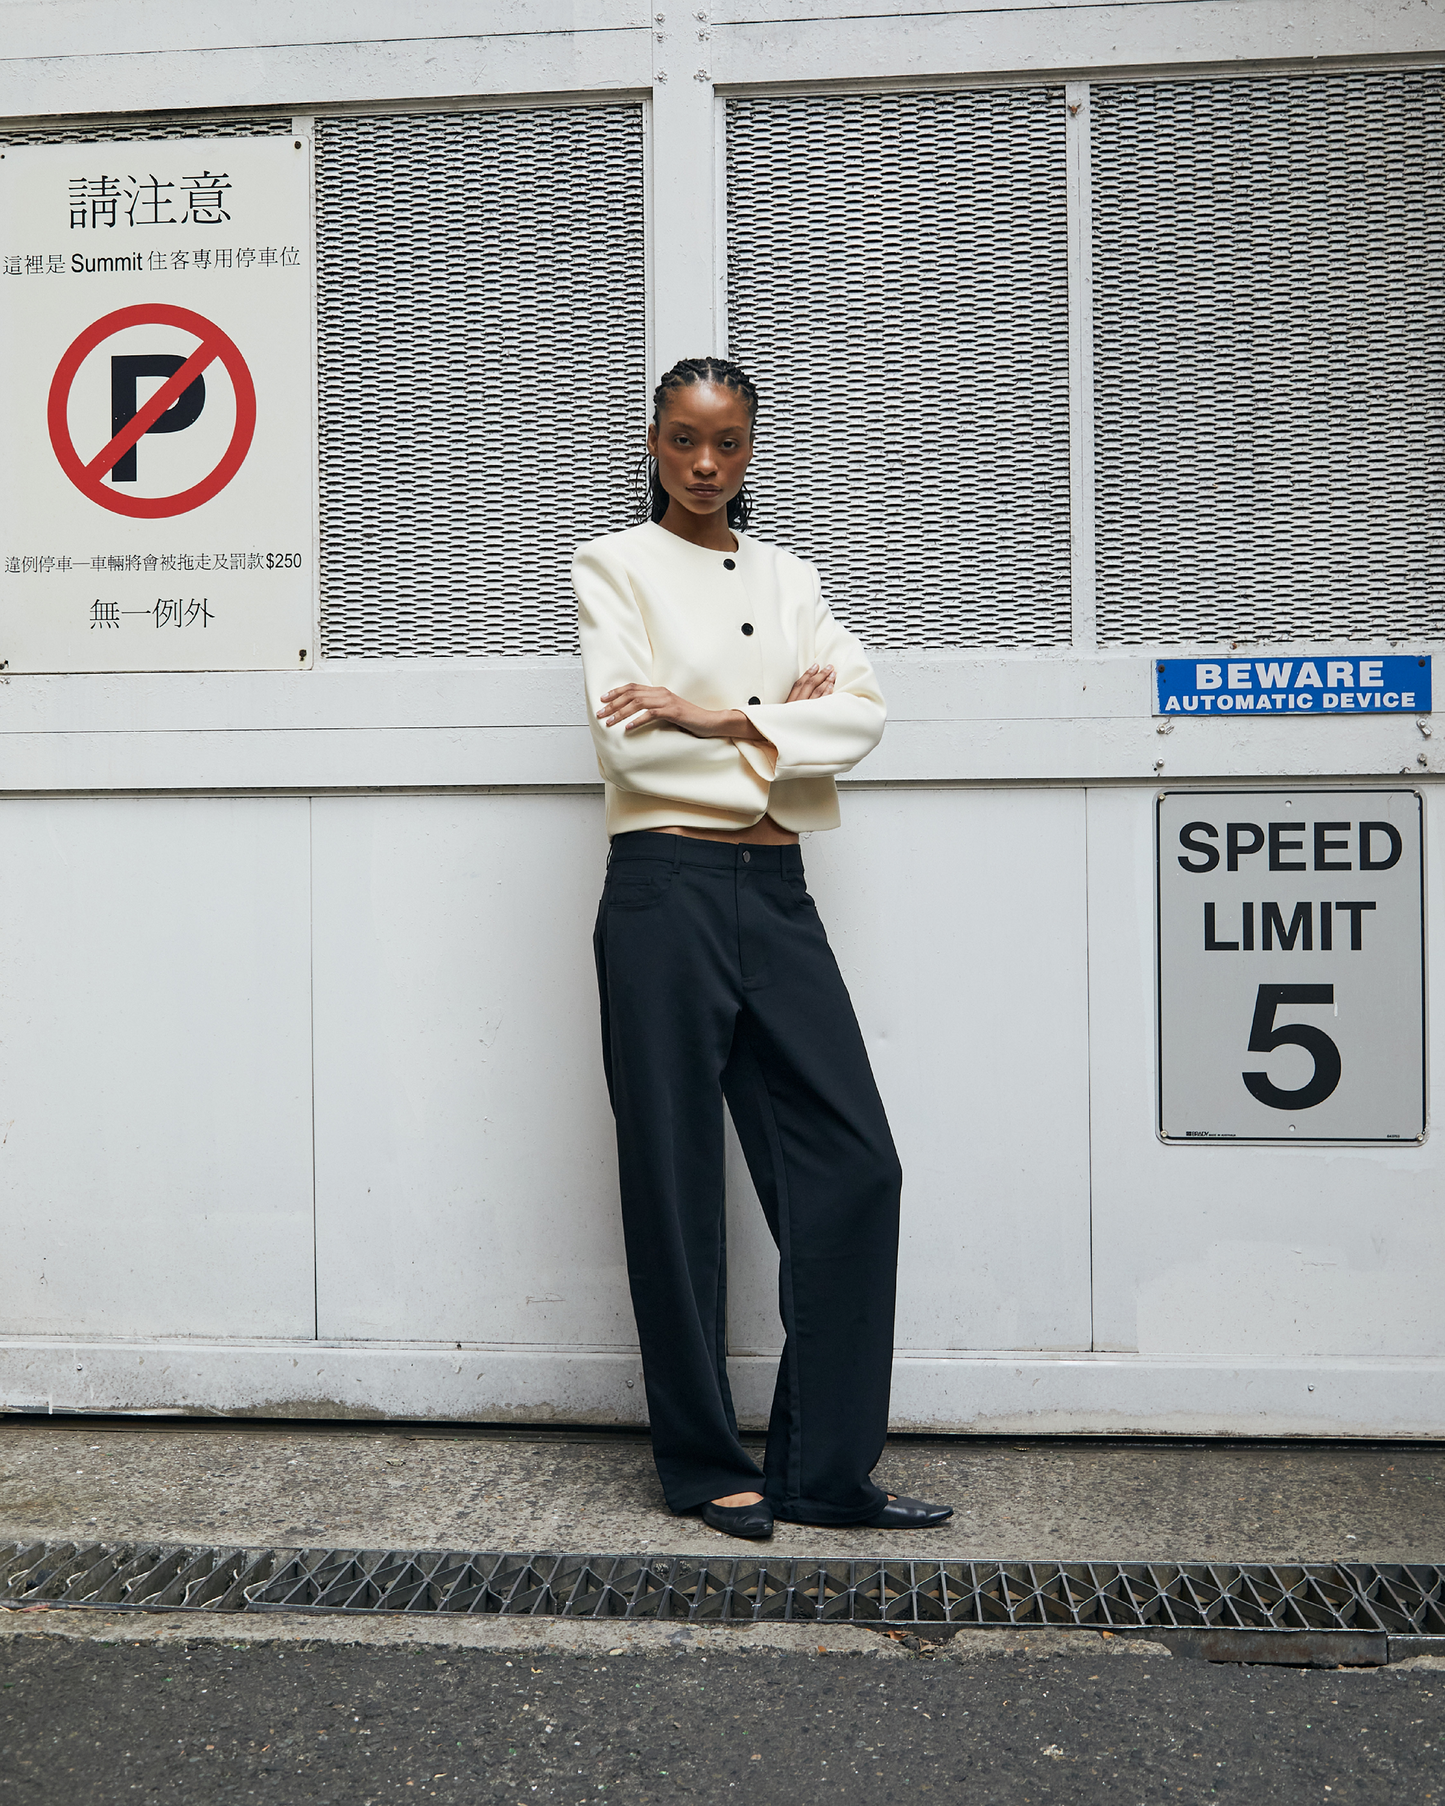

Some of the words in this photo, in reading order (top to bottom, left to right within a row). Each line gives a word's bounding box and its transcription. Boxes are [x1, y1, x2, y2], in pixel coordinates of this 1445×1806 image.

[68, 170, 233, 229] 請注意
[2, 253, 66, 276] 這裡是
[71, 252, 143, 273] Summit
[146, 246, 301, 271] 住客專用停車位
[111, 354, 206, 482] P
[89, 597, 215, 629] 無一例外
[1196, 660, 1384, 690] BEWARE
[1164, 693, 1313, 711] AUTOMATIC
[1322, 692, 1416, 709] DEVICE
[1177, 821, 1403, 874] SPEED
[1204, 901, 1377, 951] LIMIT
[1241, 983, 1342, 1111] 5
